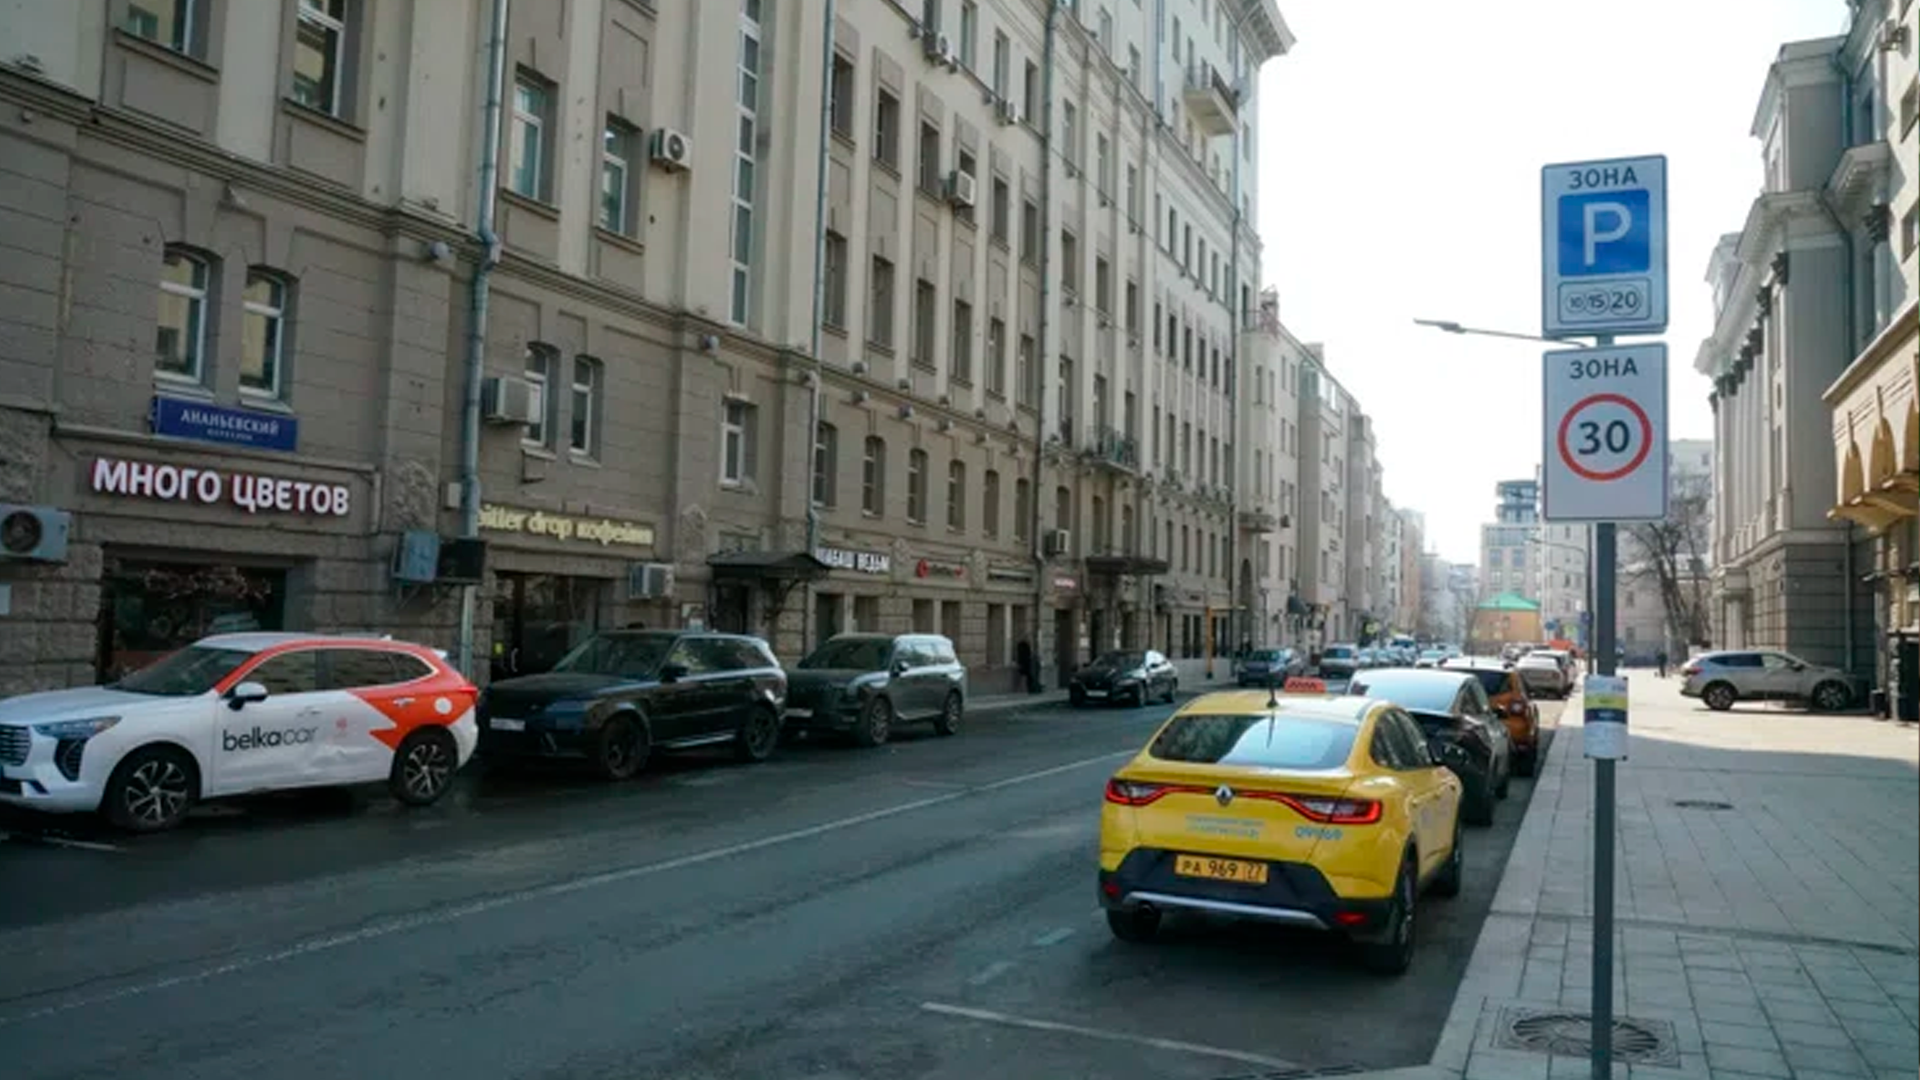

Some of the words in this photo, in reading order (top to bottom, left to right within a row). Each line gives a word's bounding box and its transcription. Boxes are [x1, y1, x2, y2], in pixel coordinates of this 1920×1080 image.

[1569, 166, 1638, 190] ЗОНА
[1583, 201, 1632, 267] P
[1569, 296, 1584, 308] 10
[1588, 294, 1606, 309] 15
[1611, 291, 1638, 309] 20
[1569, 357, 1638, 379] ЗОНА
[180, 409, 280, 435] АНАНЬЕВСКИЙ
[1578, 420, 1630, 455] 30
[92, 458, 221, 502] МНОГО
[231, 474, 349, 515] ЦВЕТОВ
[528, 511, 574, 541] drop
[222, 726, 318, 751] belkacar
[1208, 860, 1238, 876] 969
